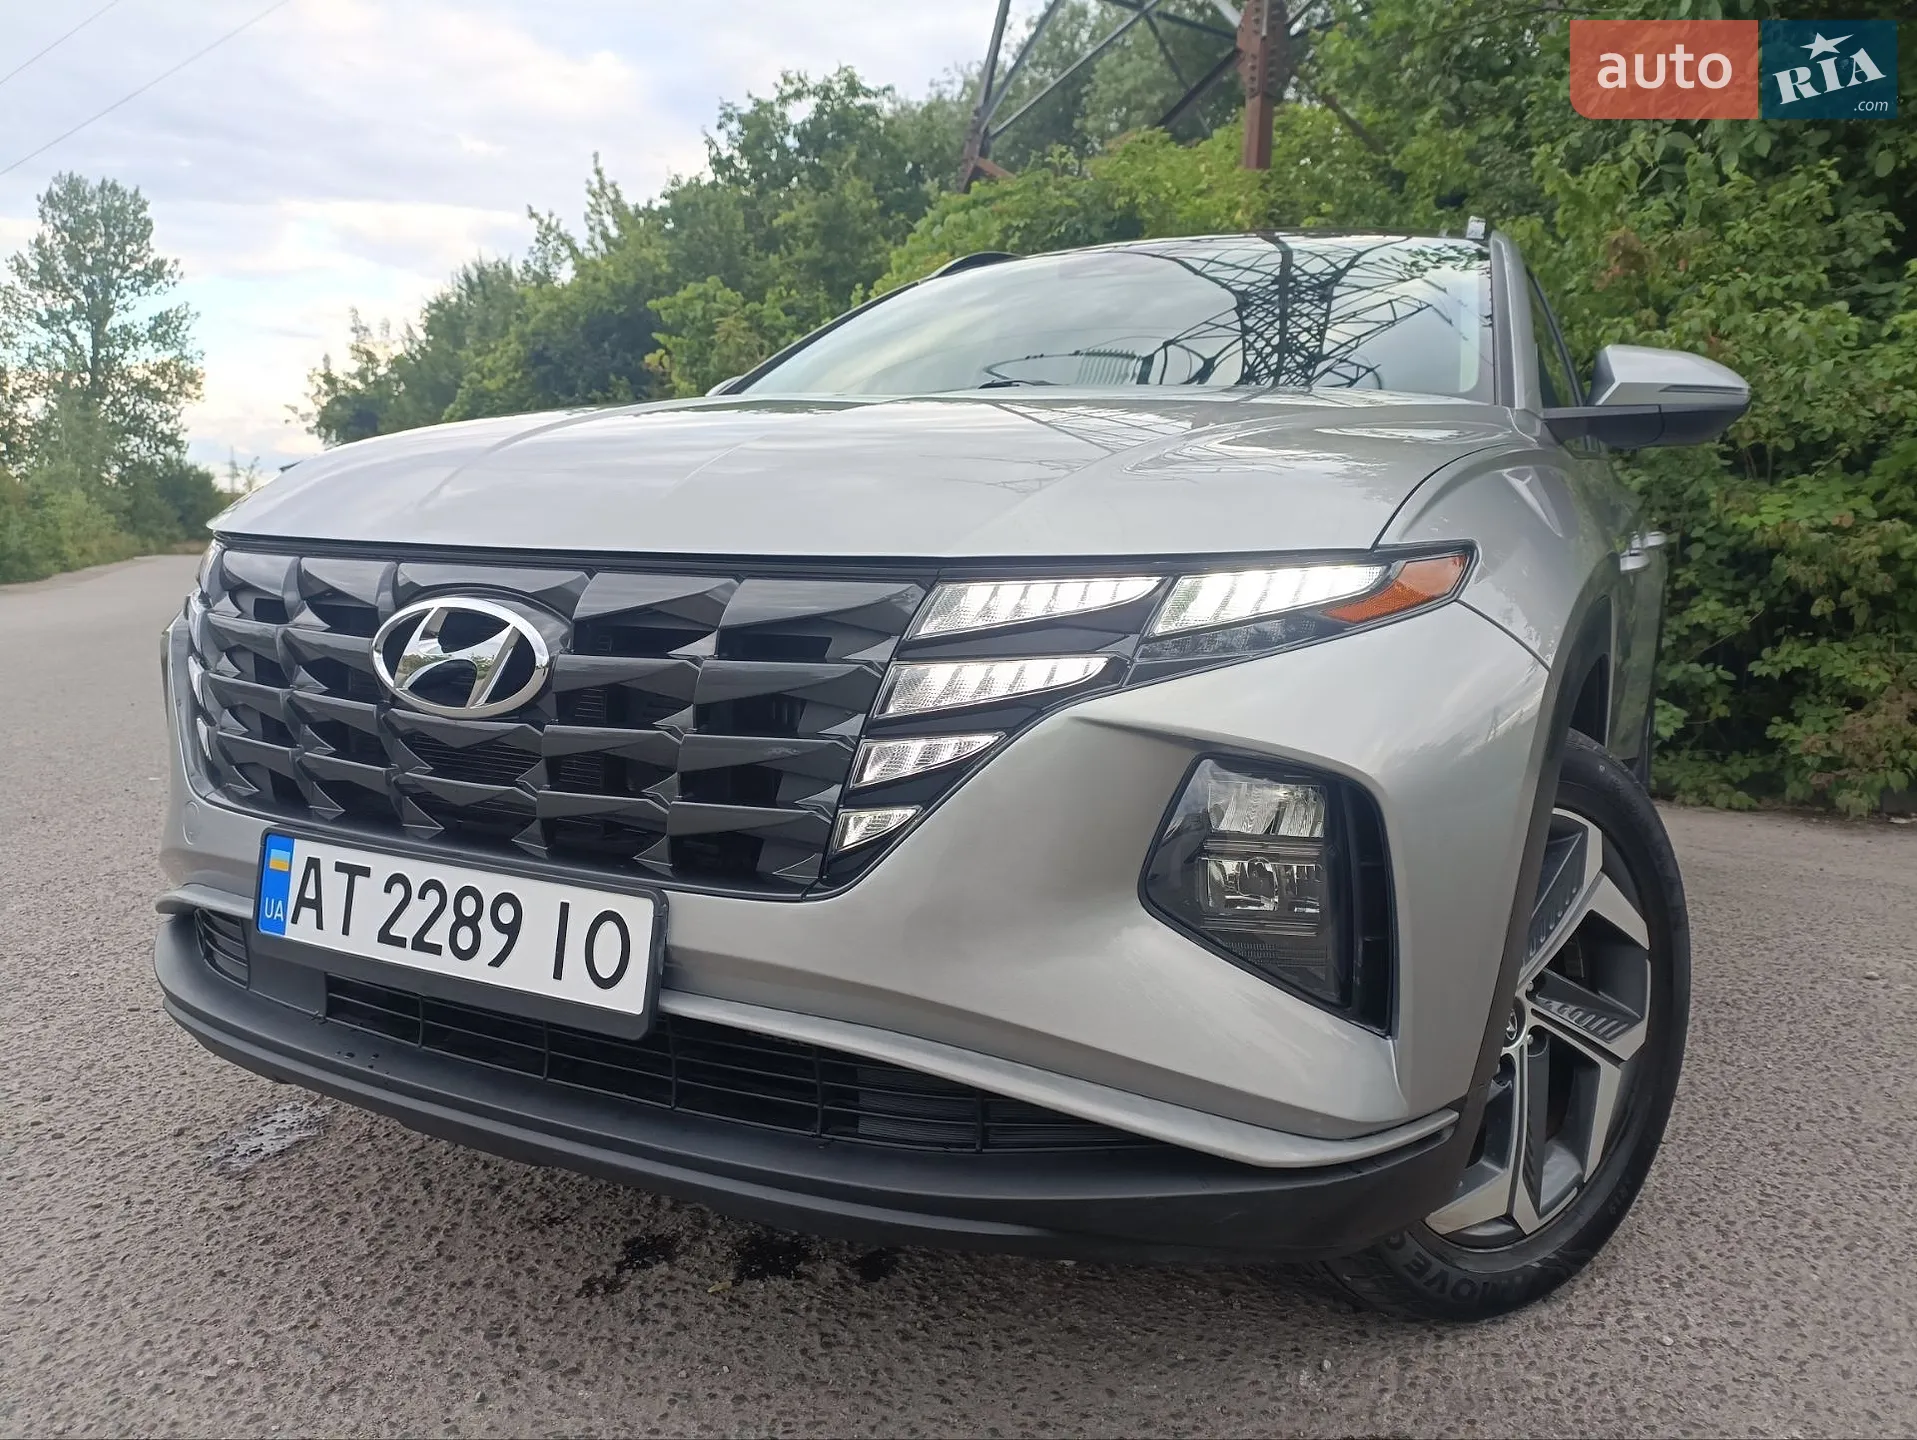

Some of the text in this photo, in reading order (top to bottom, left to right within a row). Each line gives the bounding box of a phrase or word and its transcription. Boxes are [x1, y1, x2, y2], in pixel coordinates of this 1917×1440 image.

[264, 897, 284, 922] UA
[290, 856, 631, 990] AT 2289 IO
